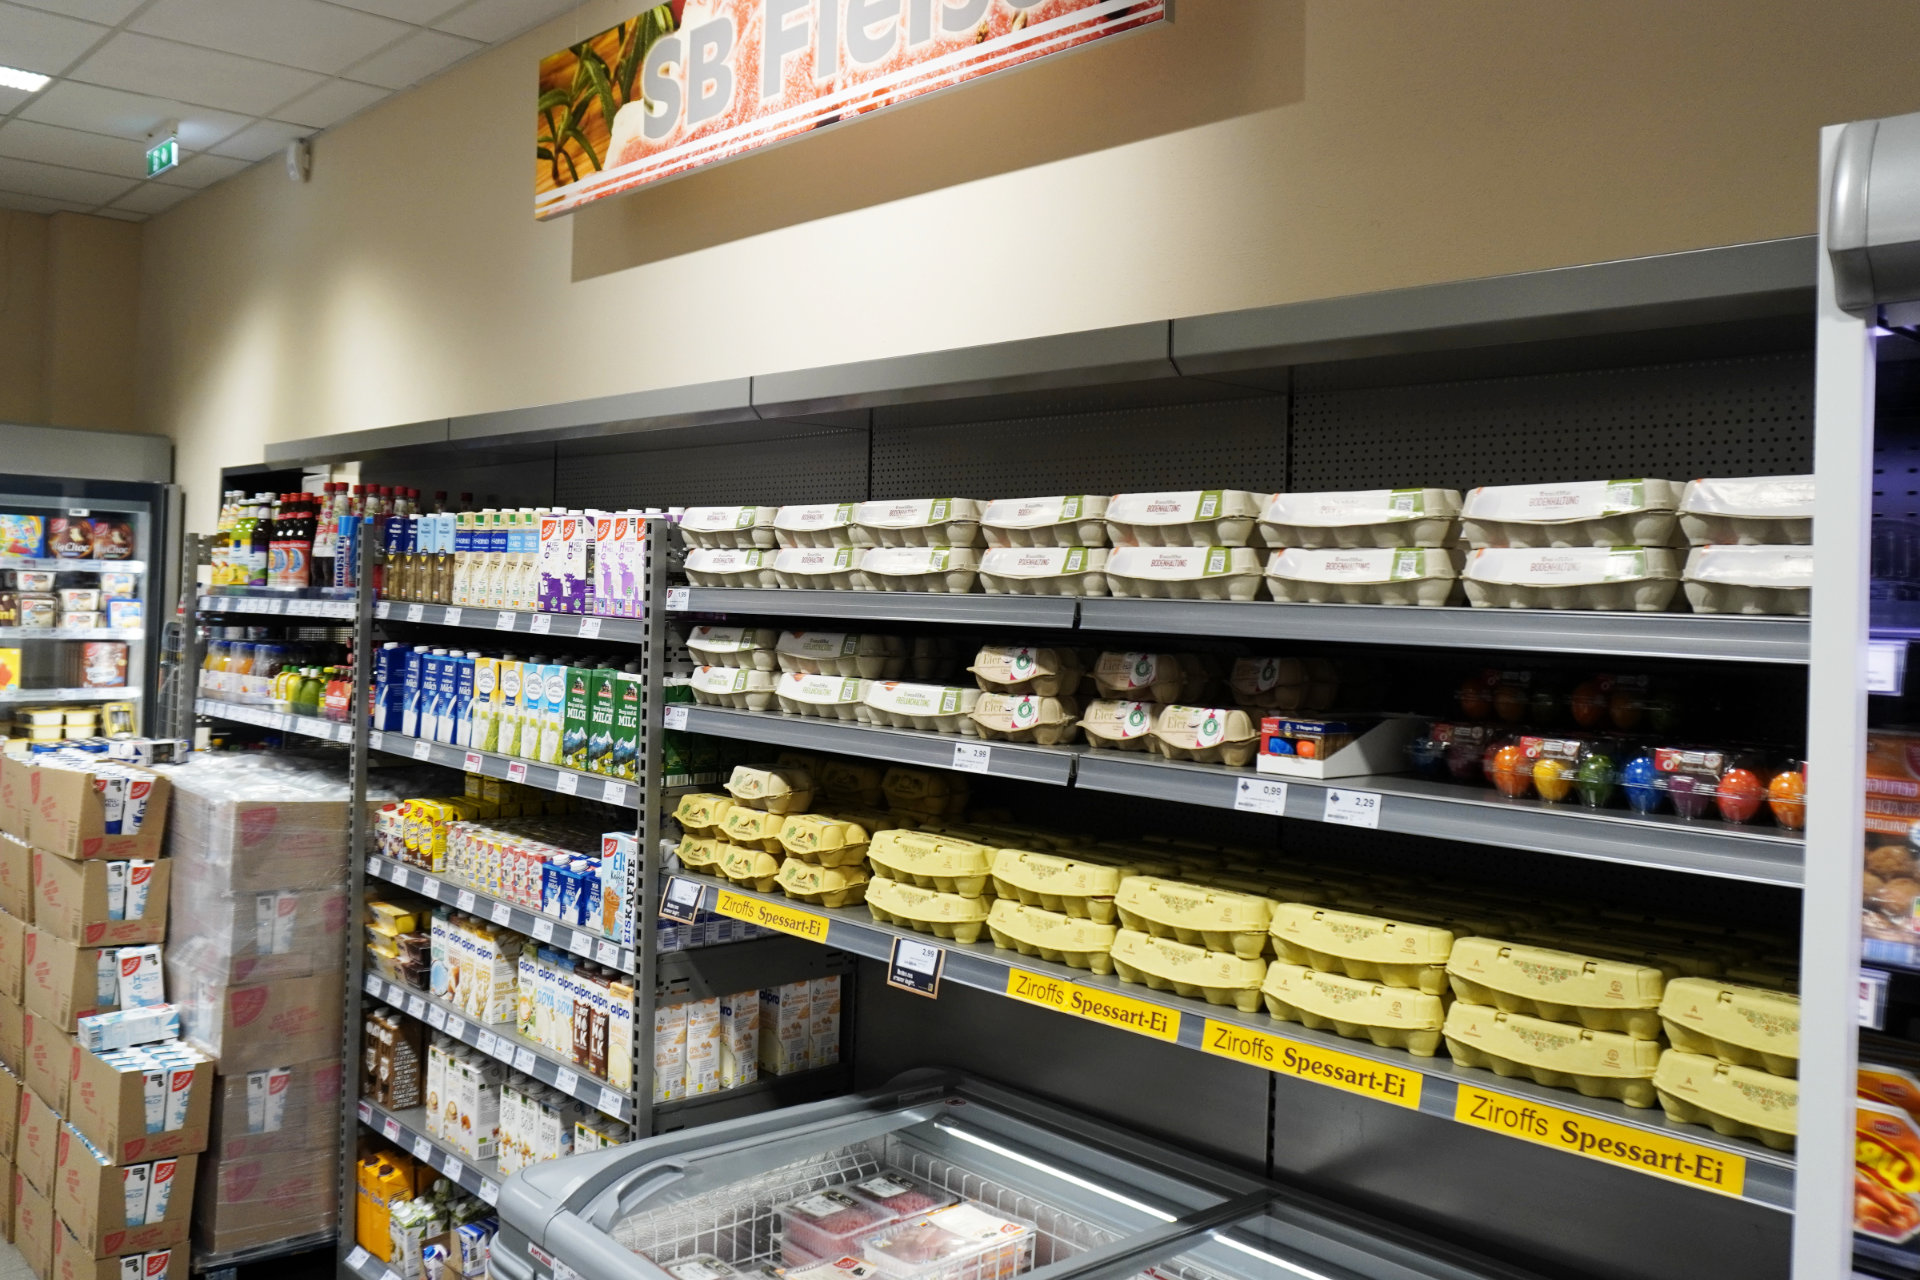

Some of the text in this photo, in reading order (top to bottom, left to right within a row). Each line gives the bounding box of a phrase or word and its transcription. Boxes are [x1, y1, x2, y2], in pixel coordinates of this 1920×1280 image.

[643, 16, 734, 140] SB
[983, 653, 1002, 665] Eier
[567, 708, 586, 720] MILCH
[984, 702, 1003, 712] Eier
[1094, 708, 1114, 720] Eier
[592, 711, 613, 724] MILCH
[1167, 716, 1187, 728] Eier
[973, 749, 987, 759] 2,99
[1263, 785, 1282, 796] 0,99
[1355, 797, 1375, 808] 2,29
[624, 858, 636, 944] EISKAFFEE
[721, 895, 822, 937] Ziroffs Spessart-Ei
[476, 946, 493, 960] alpro
[922, 948, 935, 958] 2,99
[519, 960, 535, 974] alpro
[538, 966, 556, 982] alpro
[574, 984, 592, 1000] alpro
[759, 989, 780, 1005] alpro
[591, 994, 609, 1009] alpro
[1015, 975, 1168, 1033] Ziroffs Spessart-Ei
[610, 1003, 630, 1020] alpro
[1213, 1027, 1406, 1098] Ziroffs Spessart-Ei
[1470, 1094, 1724, 1185] Ziroffs Spessart-Ei
